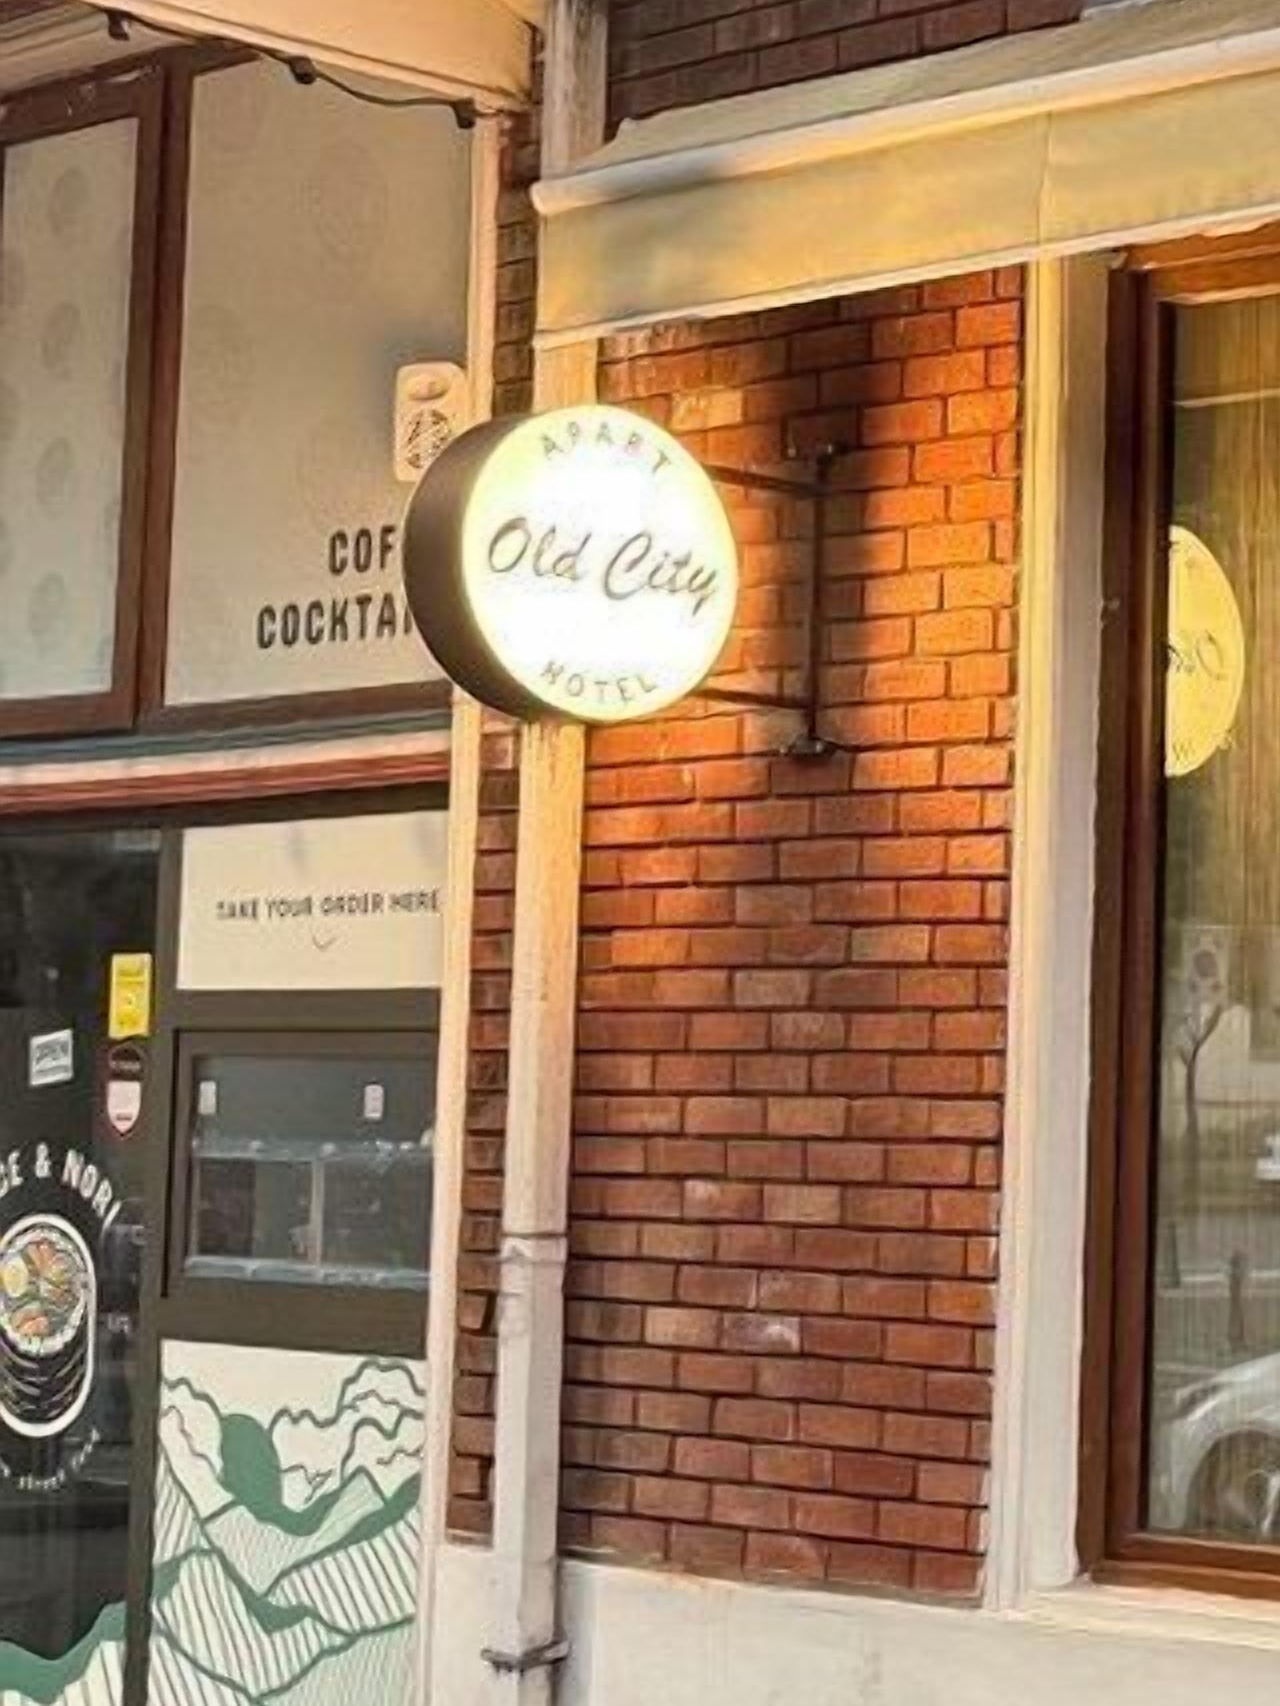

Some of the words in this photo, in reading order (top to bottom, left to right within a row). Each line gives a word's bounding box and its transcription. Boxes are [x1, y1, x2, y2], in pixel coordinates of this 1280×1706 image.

[542, 419, 672, 475] APART
[487, 516, 594, 583] Old
[603, 530, 720, 618] City
[540, 660, 658, 703] HOTEL
[266, 895, 314, 918] YOUR
